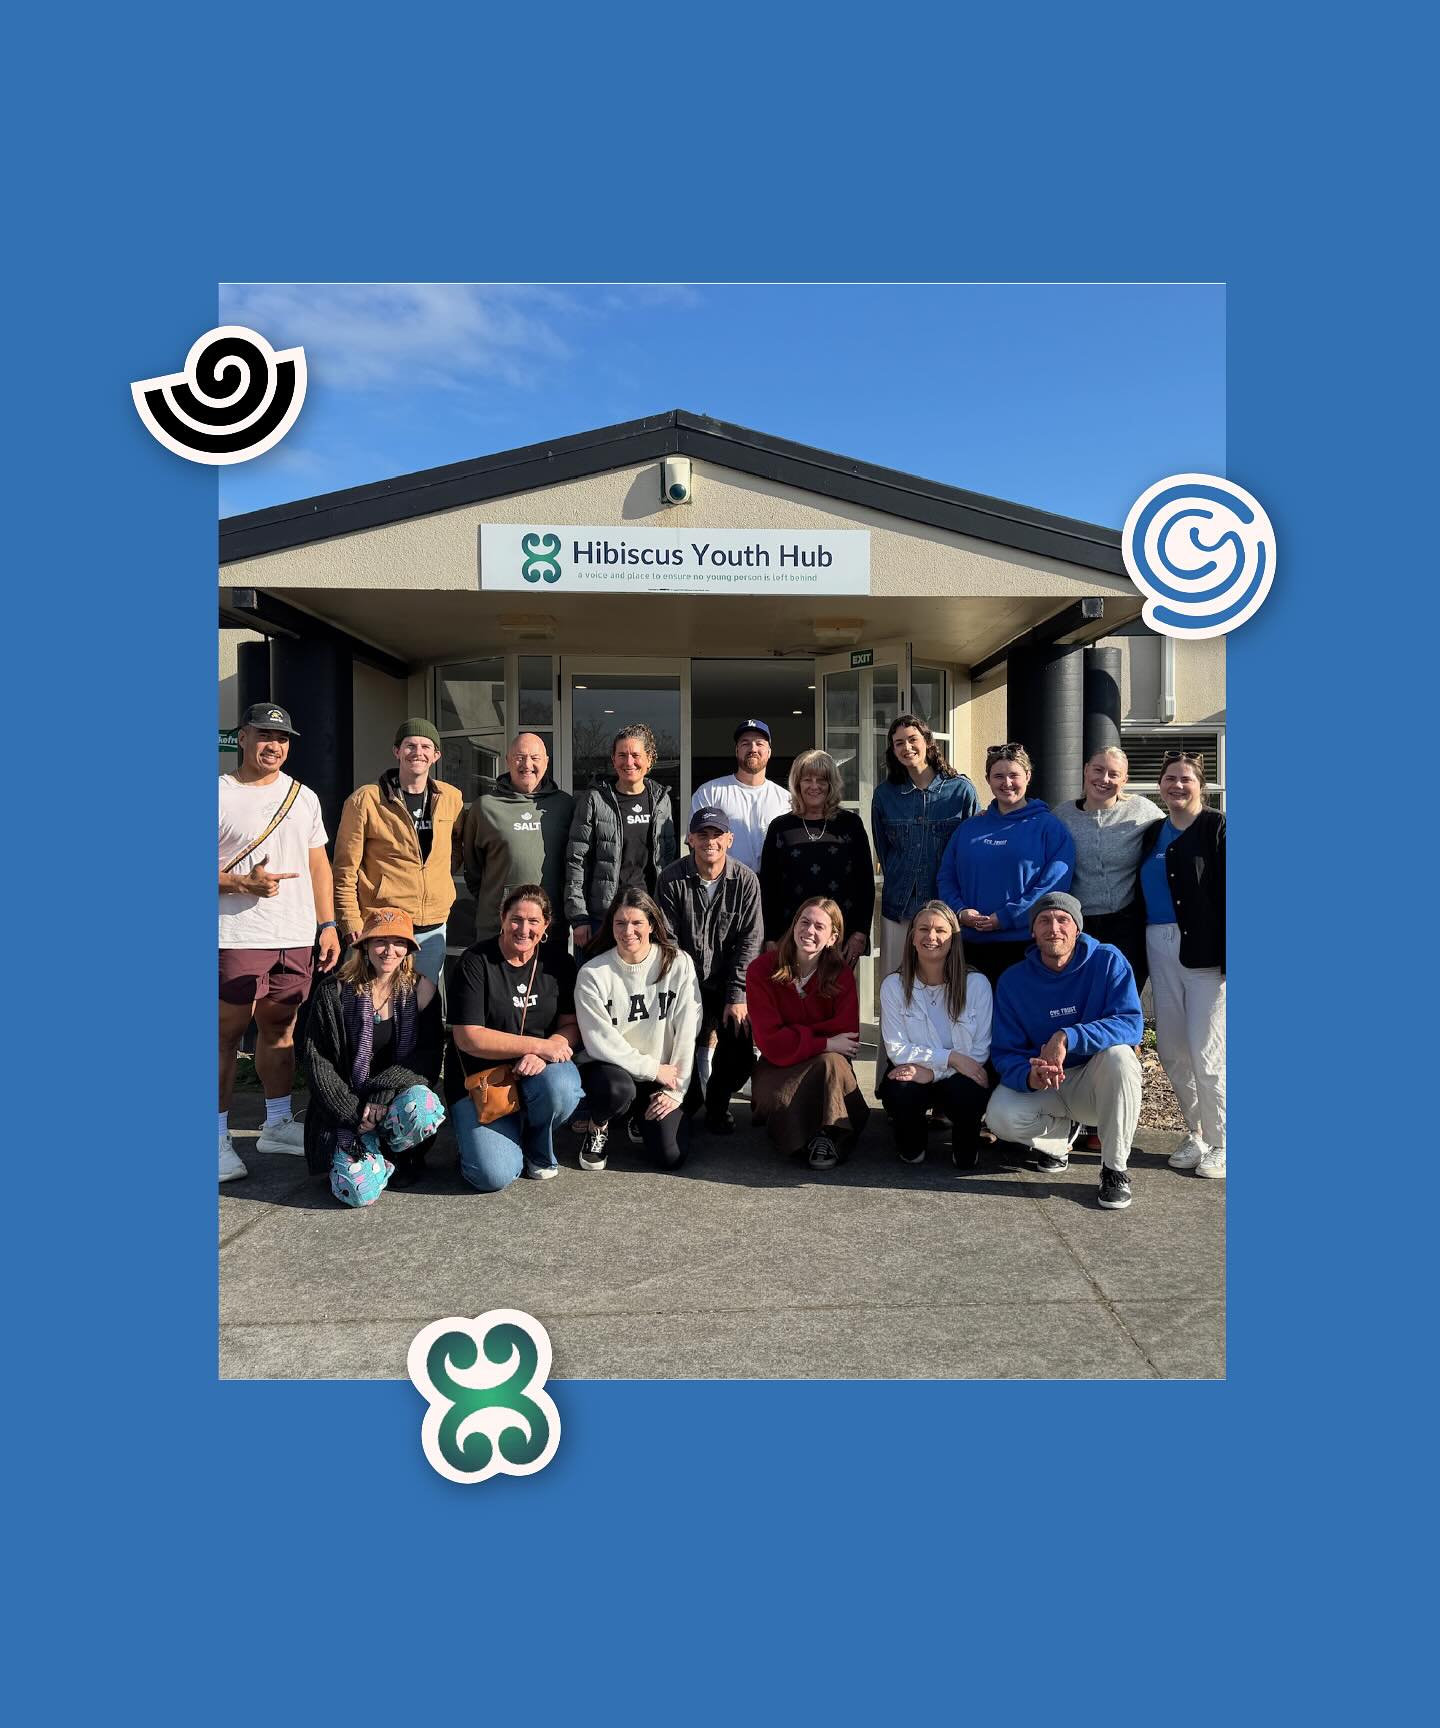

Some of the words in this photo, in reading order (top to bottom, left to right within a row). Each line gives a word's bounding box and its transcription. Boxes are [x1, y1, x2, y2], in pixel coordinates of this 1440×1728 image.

[573, 540, 684, 566] Hibiscus
[691, 543, 770, 567] Youth
[779, 544, 833, 567] Hub
[585, 571, 608, 579] voice
[610, 571, 625, 579] and
[627, 571, 650, 581] place
[652, 572, 661, 580] to
[706, 574, 732, 582] young
[733, 574, 762, 582] person
[764, 573, 771, 581] is
[772, 573, 788, 581] left
[790, 573, 818, 582] behind
[852, 653, 872, 665] EXIT
[627, 814, 651, 824] SALT
[513, 822, 541, 831] SALT
